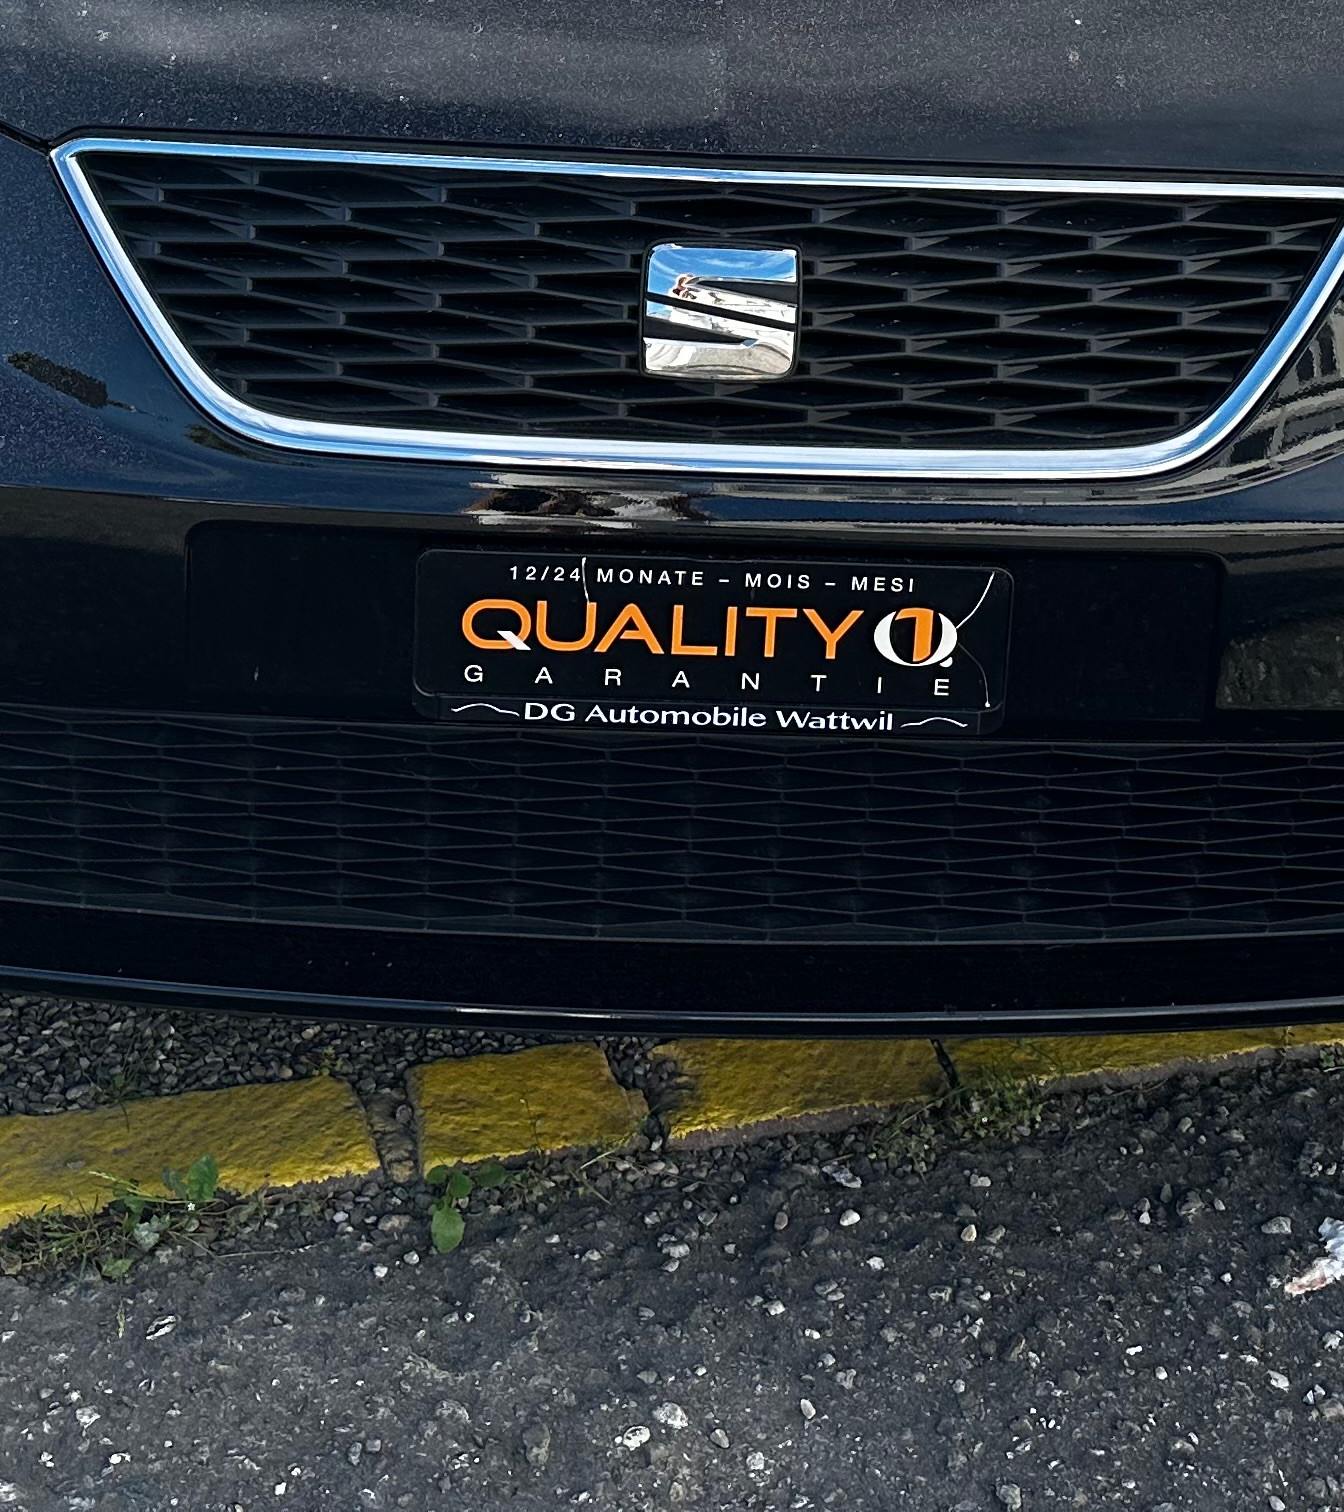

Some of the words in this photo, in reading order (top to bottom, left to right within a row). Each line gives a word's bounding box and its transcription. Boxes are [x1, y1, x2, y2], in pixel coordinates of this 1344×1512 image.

[509, 565, 580, 582] 12/24
[596, 568, 704, 586] MONATE
[745, 573, 810, 589] MOIS
[851, 576, 914, 592] MESI
[462, 599, 864, 660] QUALITY
[464, 664, 950, 696] GARANTIE
[524, 702, 575, 722] DG
[585, 705, 766, 727] Automobile
[776, 710, 893, 731] Wattwil
